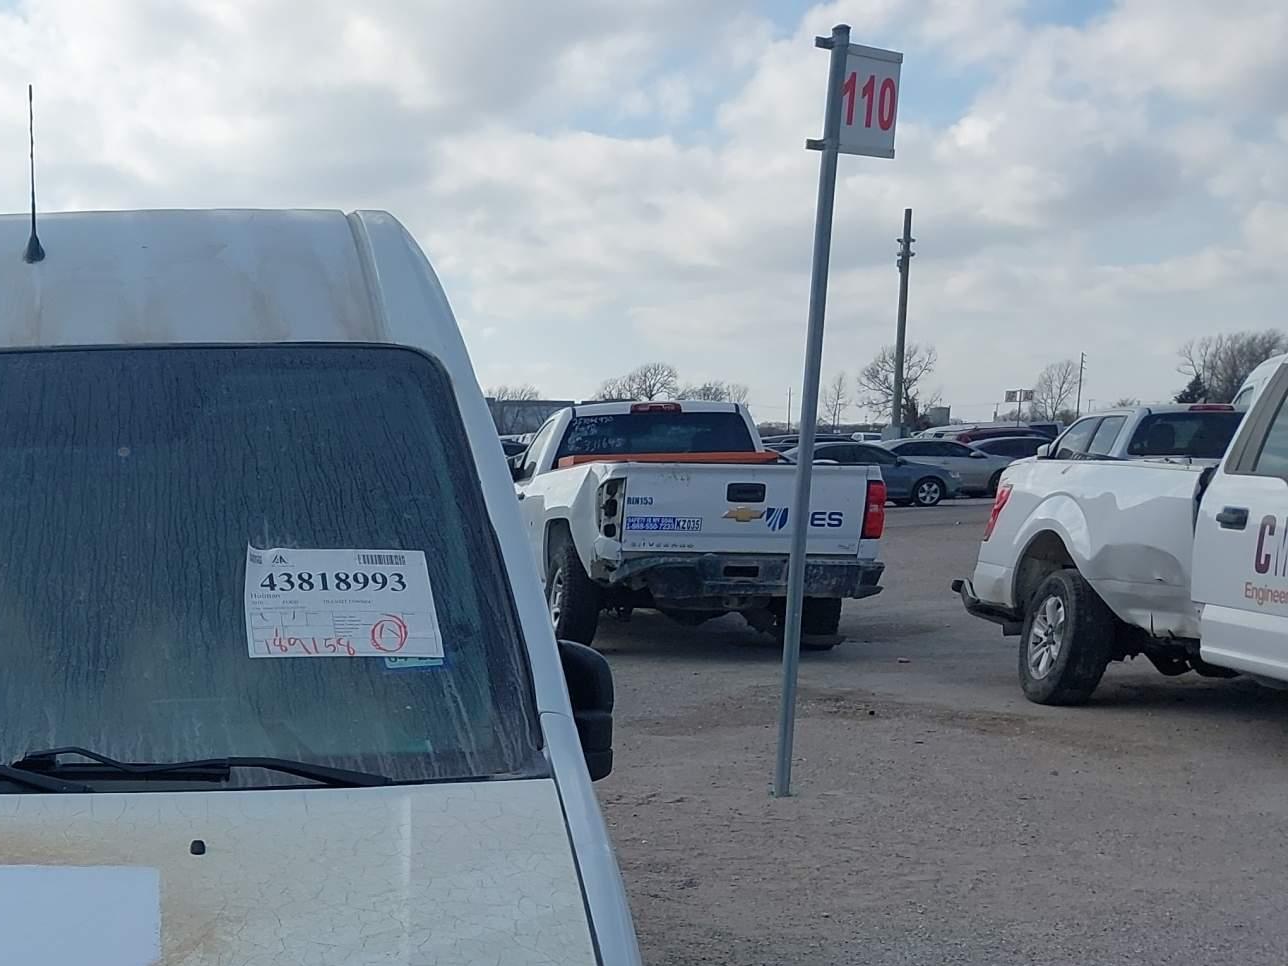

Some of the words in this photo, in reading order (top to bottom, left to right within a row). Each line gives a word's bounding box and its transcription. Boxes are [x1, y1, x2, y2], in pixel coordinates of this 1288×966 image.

[842, 72, 896, 131] 110
[810, 511, 844, 528] ES
[260, 572, 407, 592] 43818993
